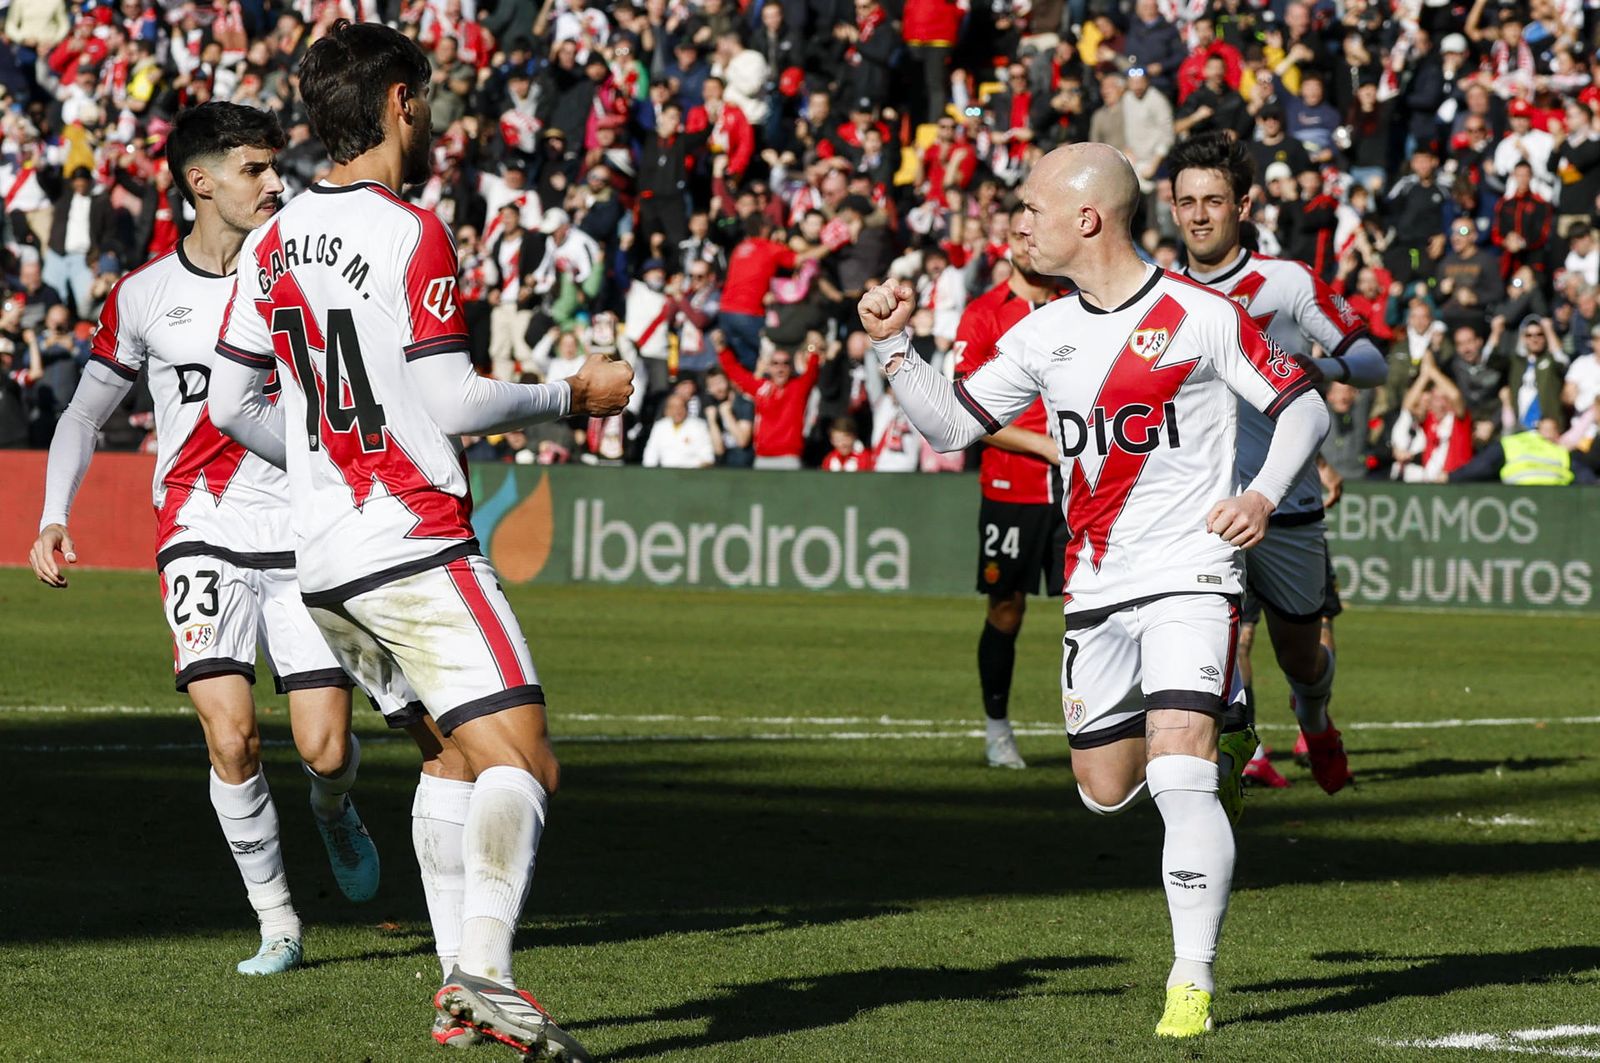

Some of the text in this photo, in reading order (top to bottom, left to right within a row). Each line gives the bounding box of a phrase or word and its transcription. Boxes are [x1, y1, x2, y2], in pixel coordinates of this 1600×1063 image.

[258, 233, 370, 300] CARLOS M.
[168, 318, 192, 327] umbro
[272, 308, 387, 452] 14
[1056, 401, 1181, 458] DIGI
[571, 498, 910, 590] Iberdrola
[984, 523, 1020, 559] 24
[173, 570, 220, 626] 23
[1397, 556, 1593, 606] JUNTOS
[1064, 637, 1079, 689] 7
